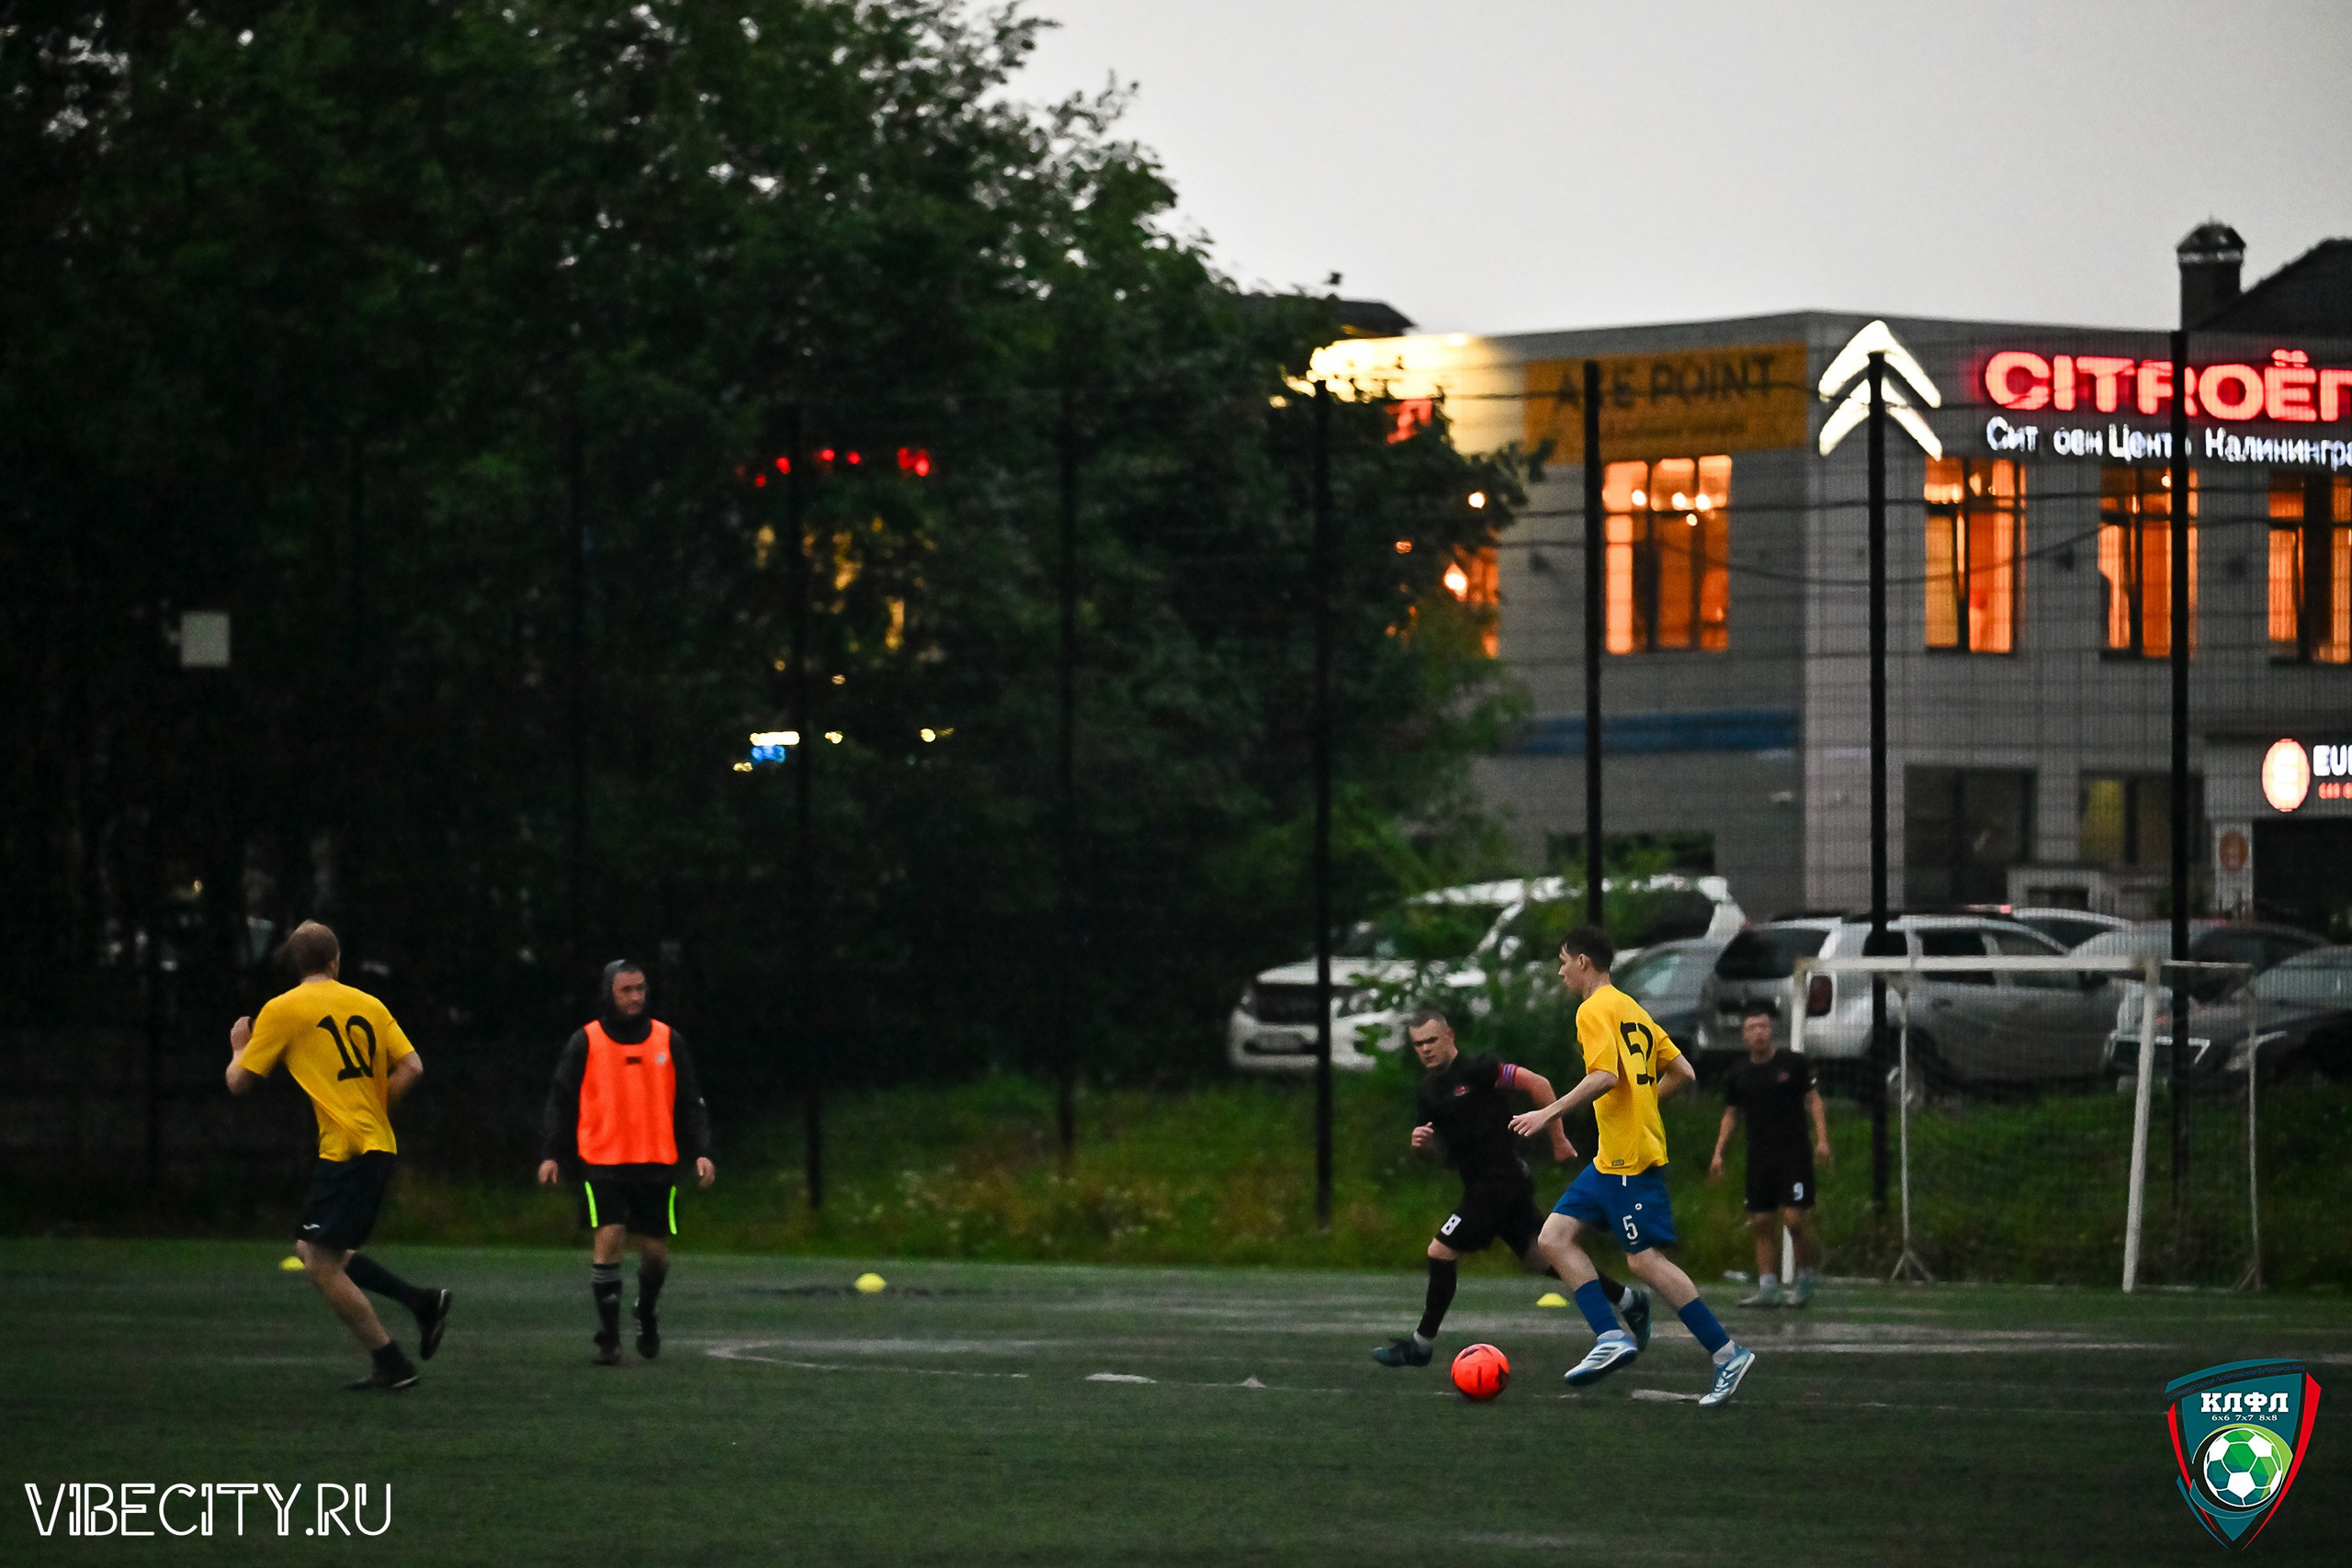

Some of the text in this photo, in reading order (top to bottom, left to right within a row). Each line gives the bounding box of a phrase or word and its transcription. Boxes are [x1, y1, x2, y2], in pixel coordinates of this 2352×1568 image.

[1556, 355, 1775, 408] AE POINT
[2312, 744, 2352, 776] EU
[316, 1015, 376, 1081] 10
[1441, 1213, 1462, 1235] 8
[1622, 1214, 1638, 1240] 5
